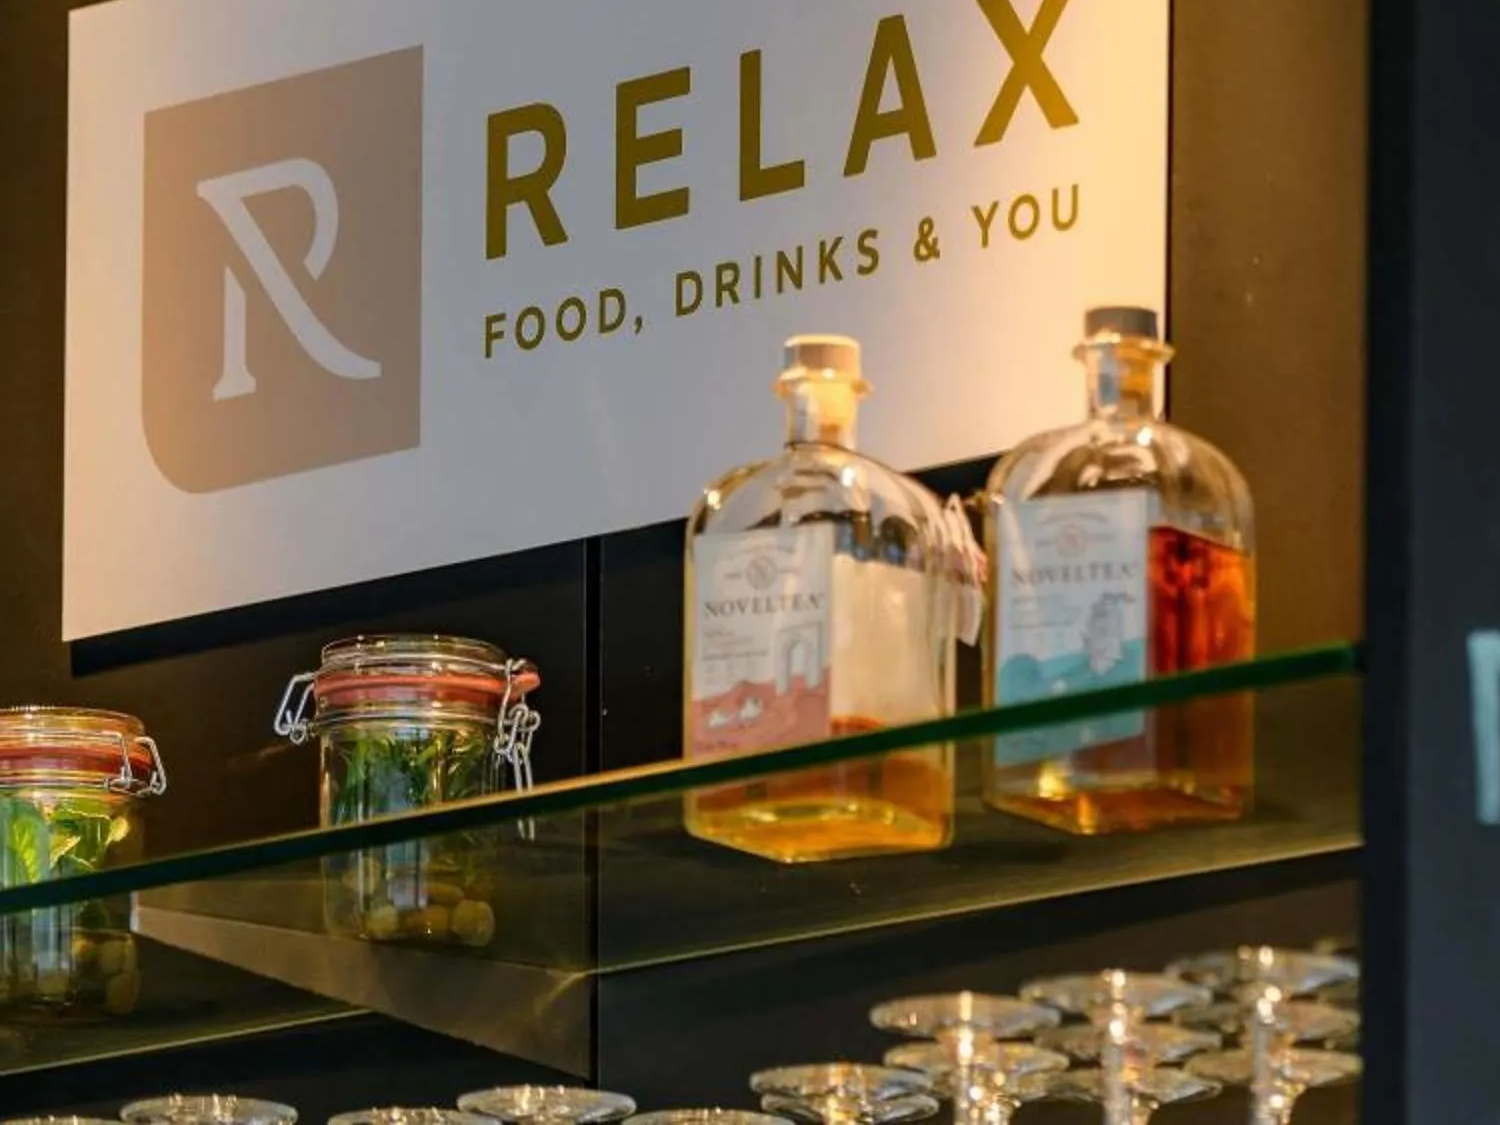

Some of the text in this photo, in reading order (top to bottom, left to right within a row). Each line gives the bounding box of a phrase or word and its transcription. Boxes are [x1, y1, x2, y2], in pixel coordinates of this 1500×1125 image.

[196, 157, 382, 402] R
[485, 184, 1079, 358] FOOD, DRINKS & YOU
